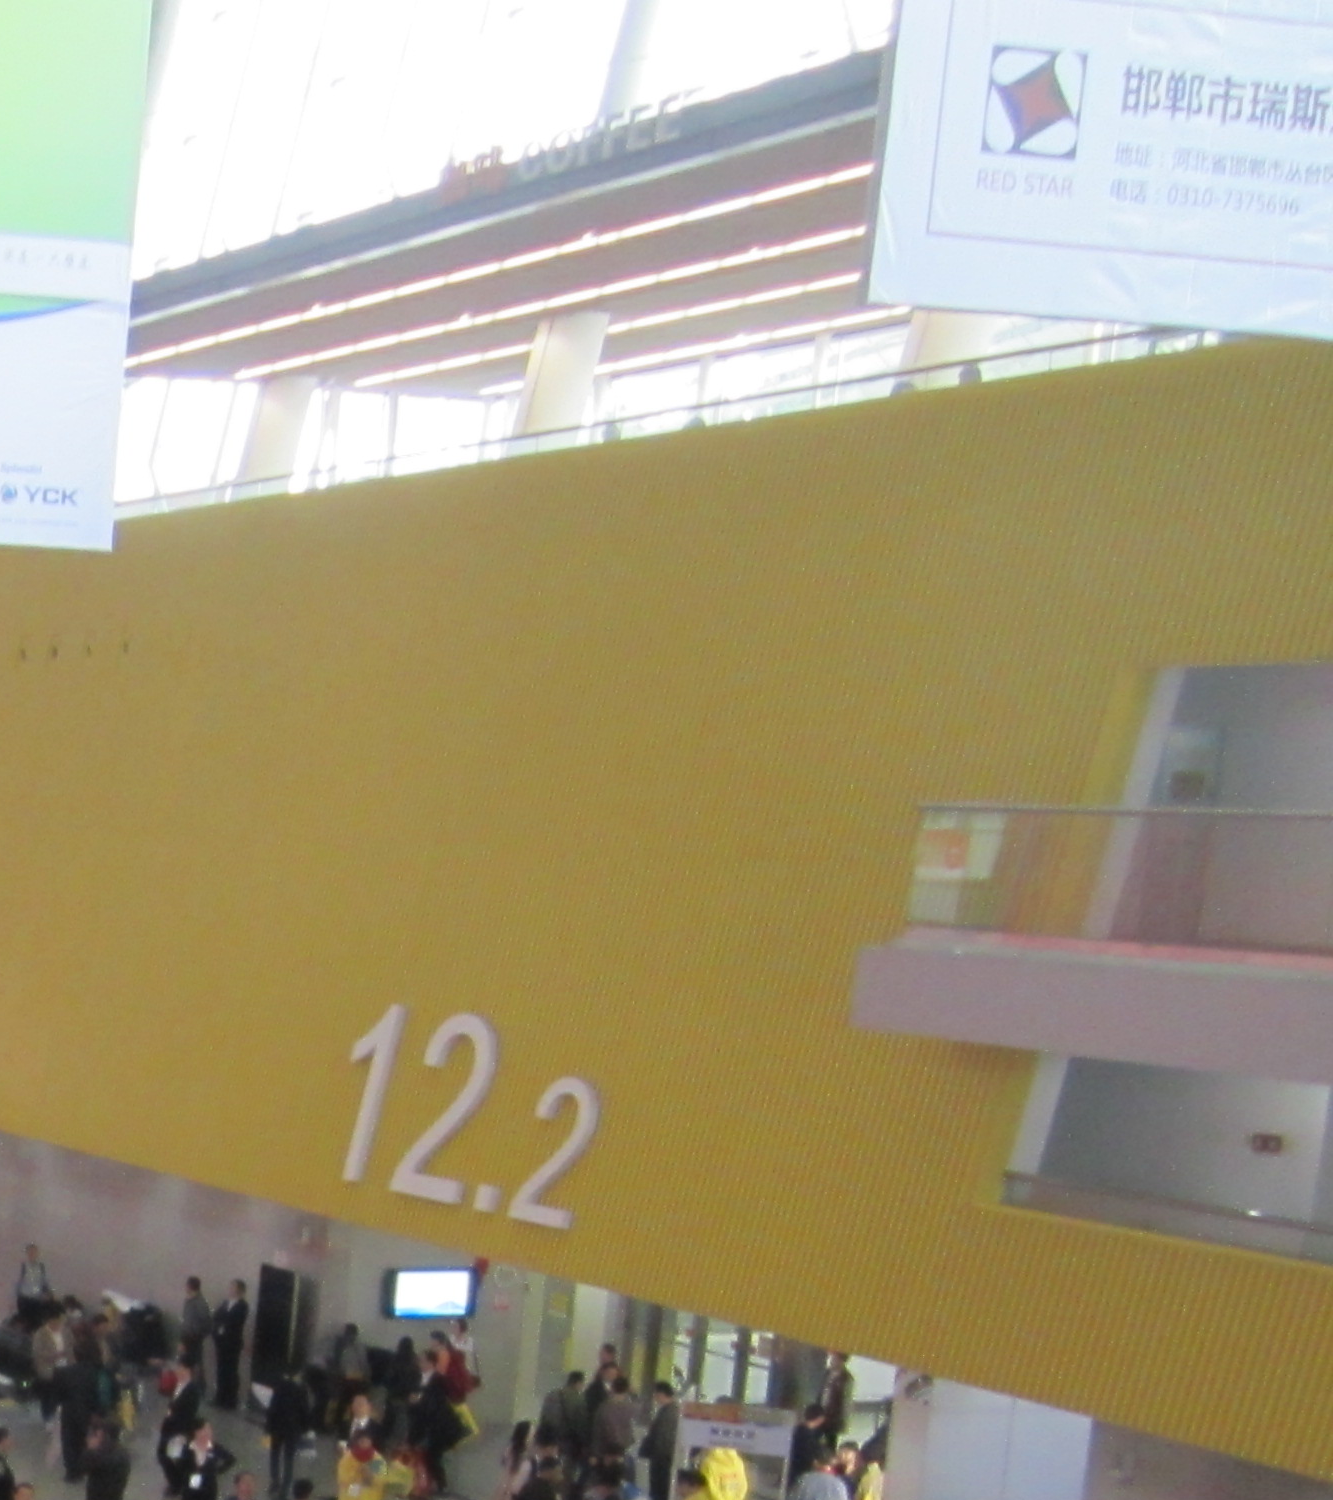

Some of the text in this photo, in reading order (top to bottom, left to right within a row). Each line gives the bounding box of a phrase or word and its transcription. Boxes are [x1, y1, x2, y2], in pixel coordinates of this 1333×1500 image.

[1121, 64, 1333, 136] 邯郸市瑞斯
[977, 167, 1073, 199] RED STAR
[24, 484, 79, 507] YCK
[341, 1003, 603, 1230] 12.2
